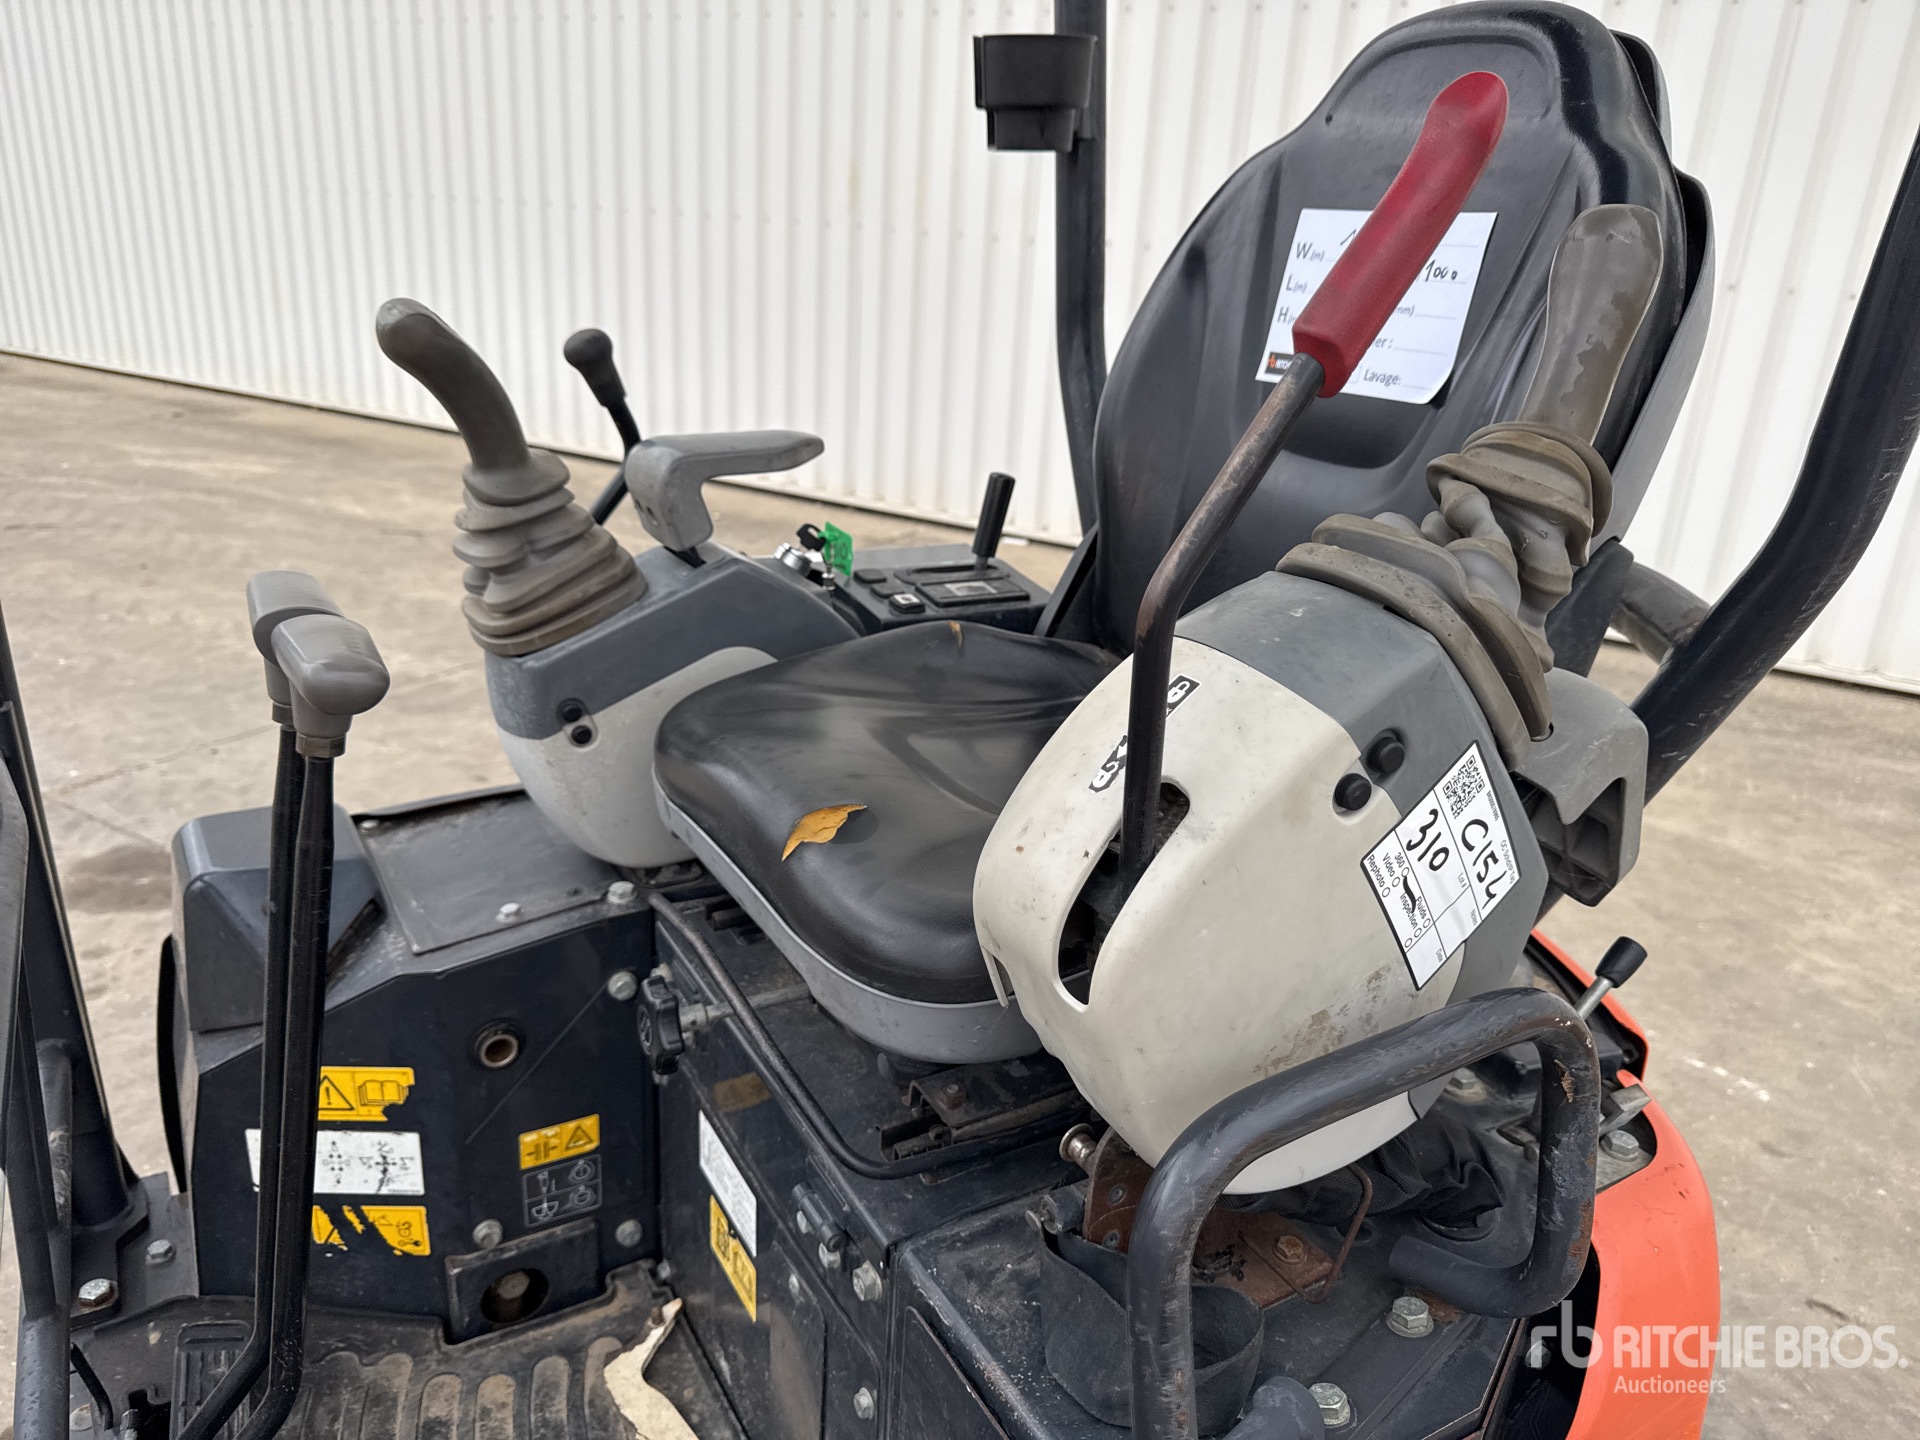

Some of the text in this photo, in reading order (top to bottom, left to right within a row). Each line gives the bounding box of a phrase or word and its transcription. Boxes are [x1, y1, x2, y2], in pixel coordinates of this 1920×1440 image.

[1424, 259, 1458, 282] 1000
[1406, 808, 1450, 872] 310
[1367, 854, 1386, 888] Rephoto
[1382, 852, 1396, 877] Video
[1394, 852, 1405, 868] 360
[1400, 892, 1419, 930] Inspection
[1415, 896, 1428, 920] Fluids
[1435, 949, 1443, 963] Date
